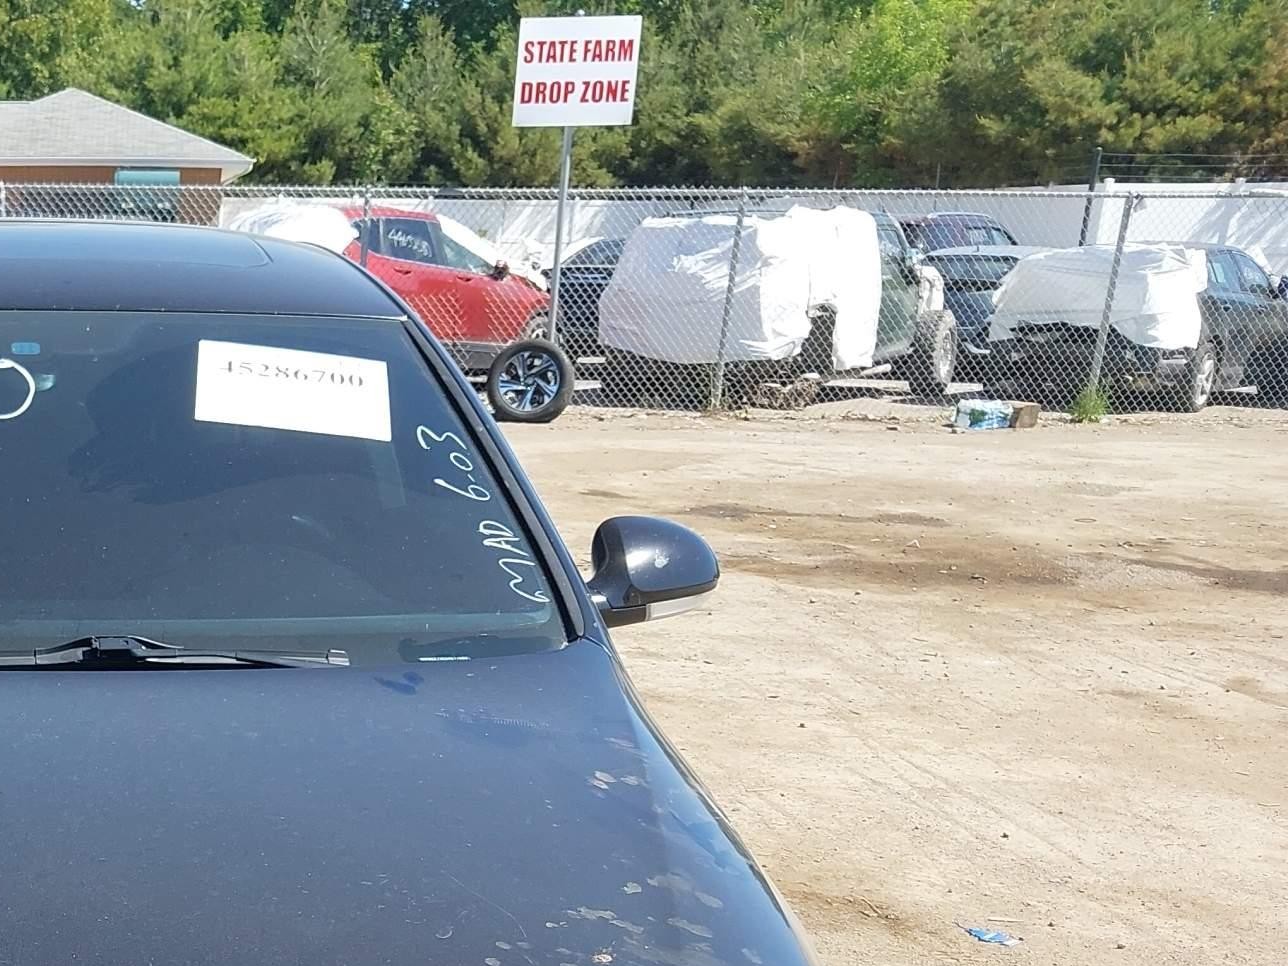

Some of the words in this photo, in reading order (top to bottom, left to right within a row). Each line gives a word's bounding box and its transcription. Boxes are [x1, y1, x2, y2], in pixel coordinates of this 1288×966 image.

[523, 40, 578, 64] STATE
[582, 39, 634, 62] FARM
[520, 81, 575, 105] DROP
[580, 80, 630, 103] ZONE
[219, 360, 364, 387] 45286700
[416, 425, 491, 501] 6-03
